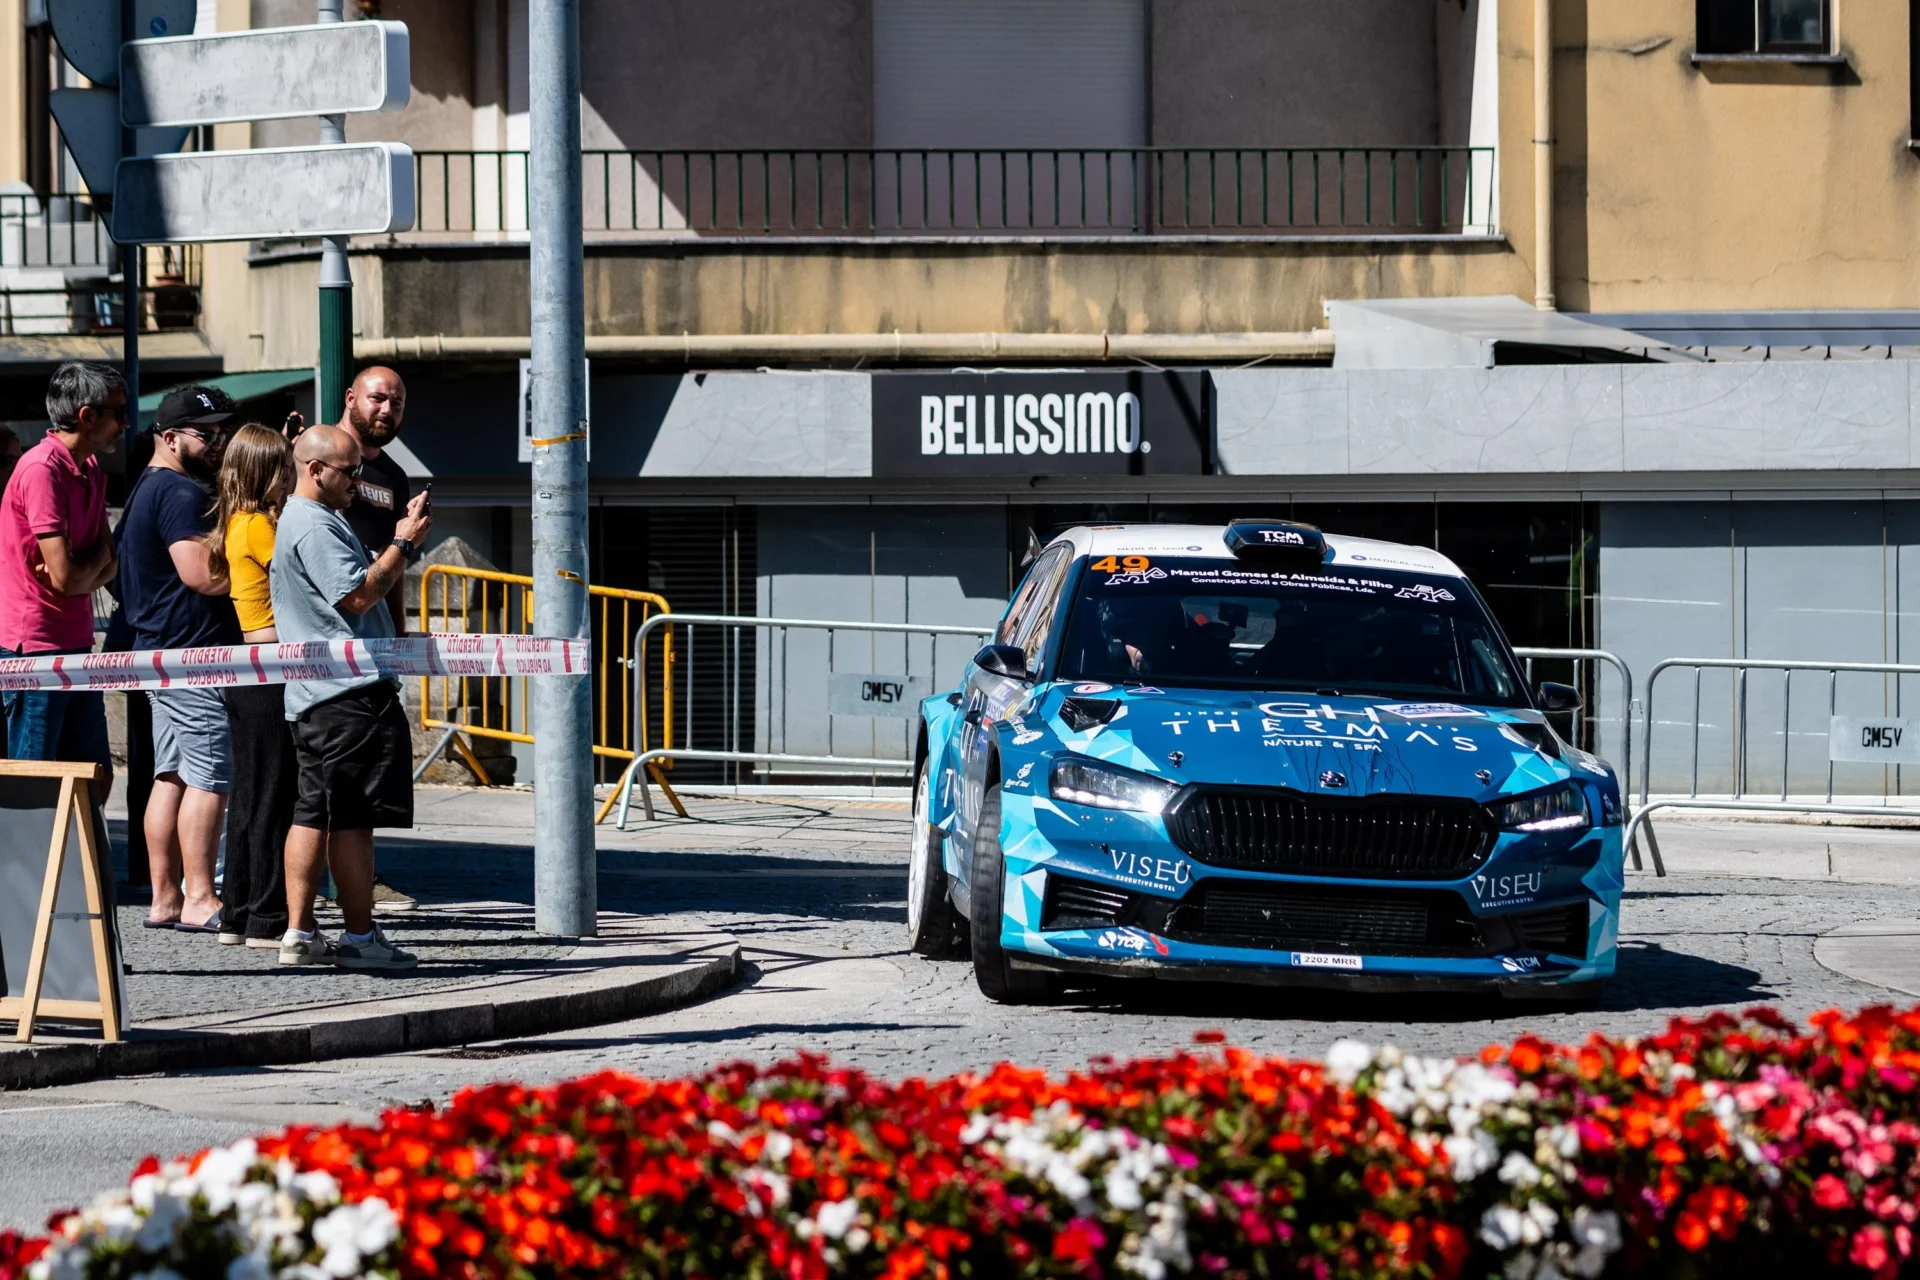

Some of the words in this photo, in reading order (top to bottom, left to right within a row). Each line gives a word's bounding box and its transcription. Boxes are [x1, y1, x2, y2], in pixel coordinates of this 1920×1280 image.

[921, 392, 1141, 455] BELLISSIMO
[1258, 531, 1304, 542] TCM
[1091, 555, 1149, 573] 49
[1170, 569, 1219, 577] Manuel
[1221, 570, 1268, 578] Gomes
[1290, 573, 1346, 584] Almeida
[1361, 579, 1394, 589] Filho
[1191, 577, 1247, 585] Construção
[1280, 580, 1309, 588] Obras
[1311, 582, 1354, 592] Públicas,
[1355, 586, 1376, 594] Lda.
[1258, 702, 1381, 723] GH
[1161, 715, 1478, 752] THERMAS
[1264, 739, 1323, 747] NATURE
[1332, 740, 1344, 748] &
[1354, 743, 1382, 752] SPA
[1110, 849, 1192, 884] VISEU
[1115, 874, 1153, 887] EXECUTIVE
[1153, 882, 1176, 892] HOTEL
[1471, 872, 1541, 899] VISEU
[1481, 899, 1515, 908] EXECUTIVE
[1515, 896, 1534, 904] HOTEL
[1304, 955, 1329, 964] 2202
[1332, 957, 1357, 966] MRR
[1517, 956, 1541, 968] TCM
